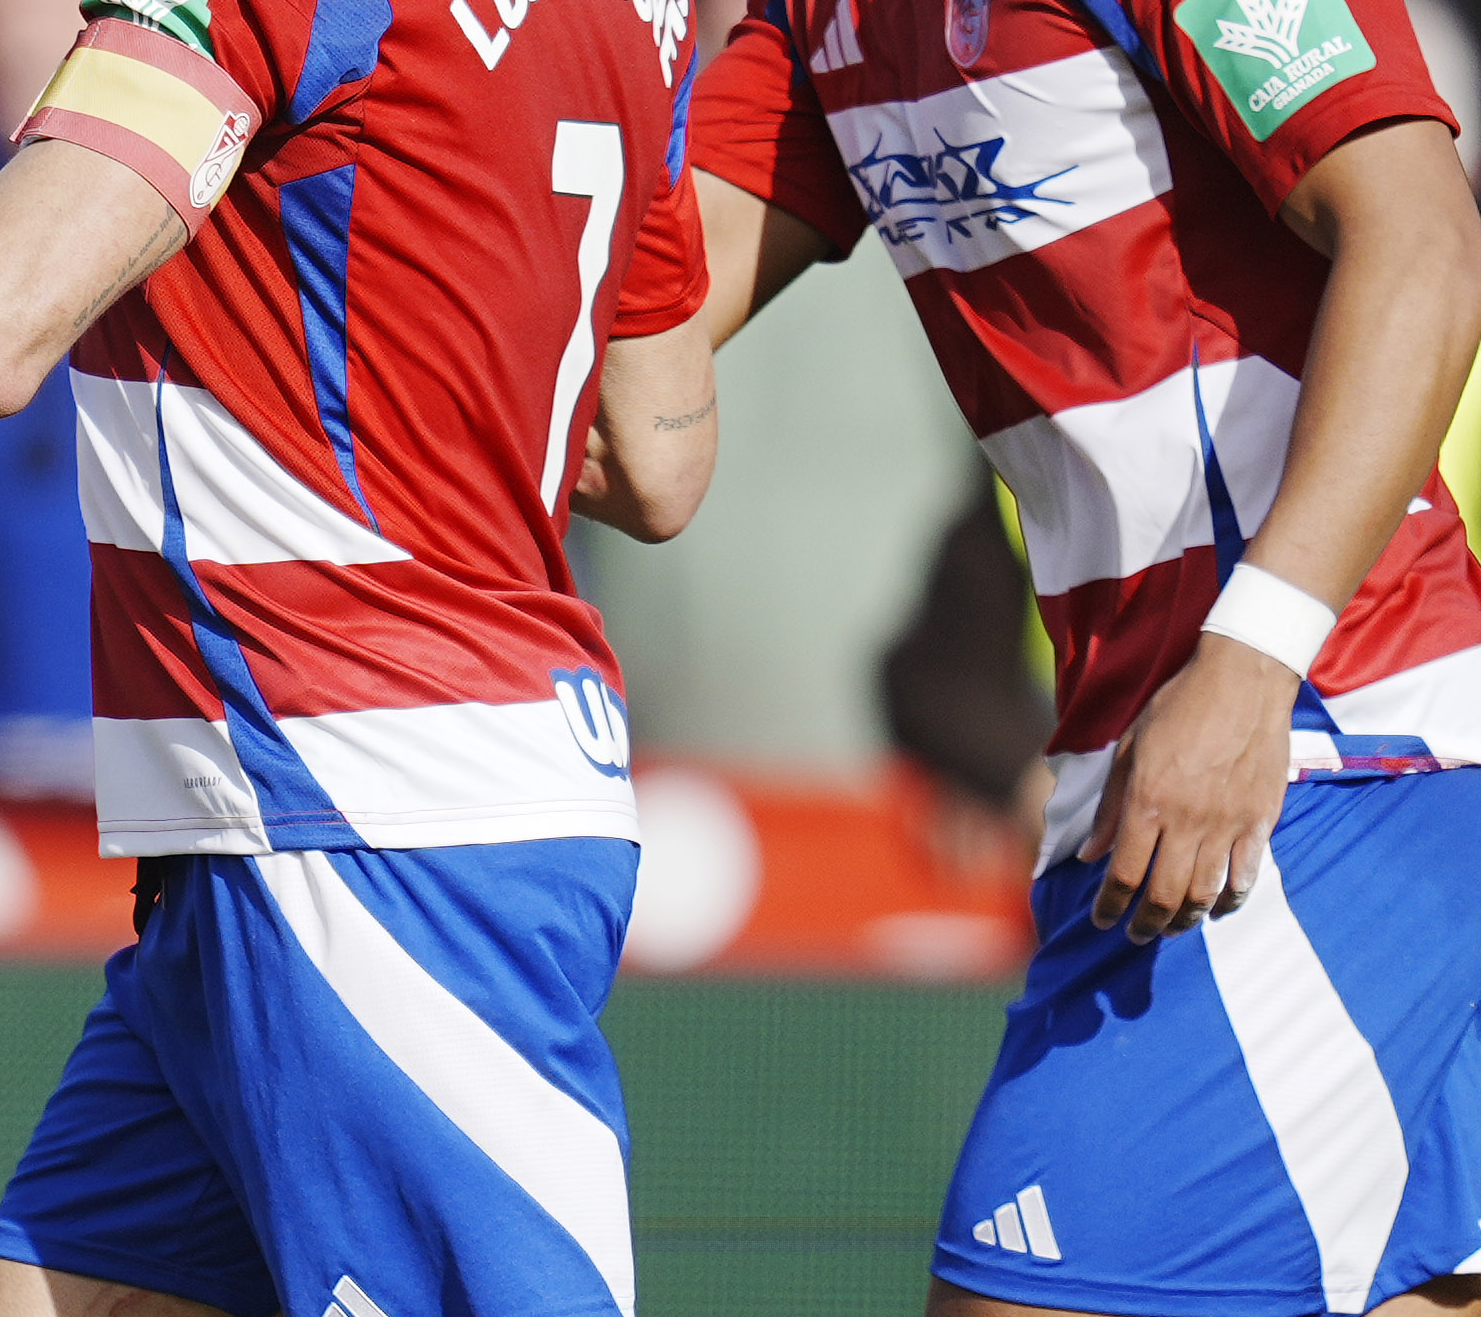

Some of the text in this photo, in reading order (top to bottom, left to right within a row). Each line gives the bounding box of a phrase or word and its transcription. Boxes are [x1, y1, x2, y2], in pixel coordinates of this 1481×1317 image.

[1247, 35, 1353, 113] CAJA RURAL
[1272, 62, 1335, 111] GRANADA
[540, 118, 626, 518] 7
